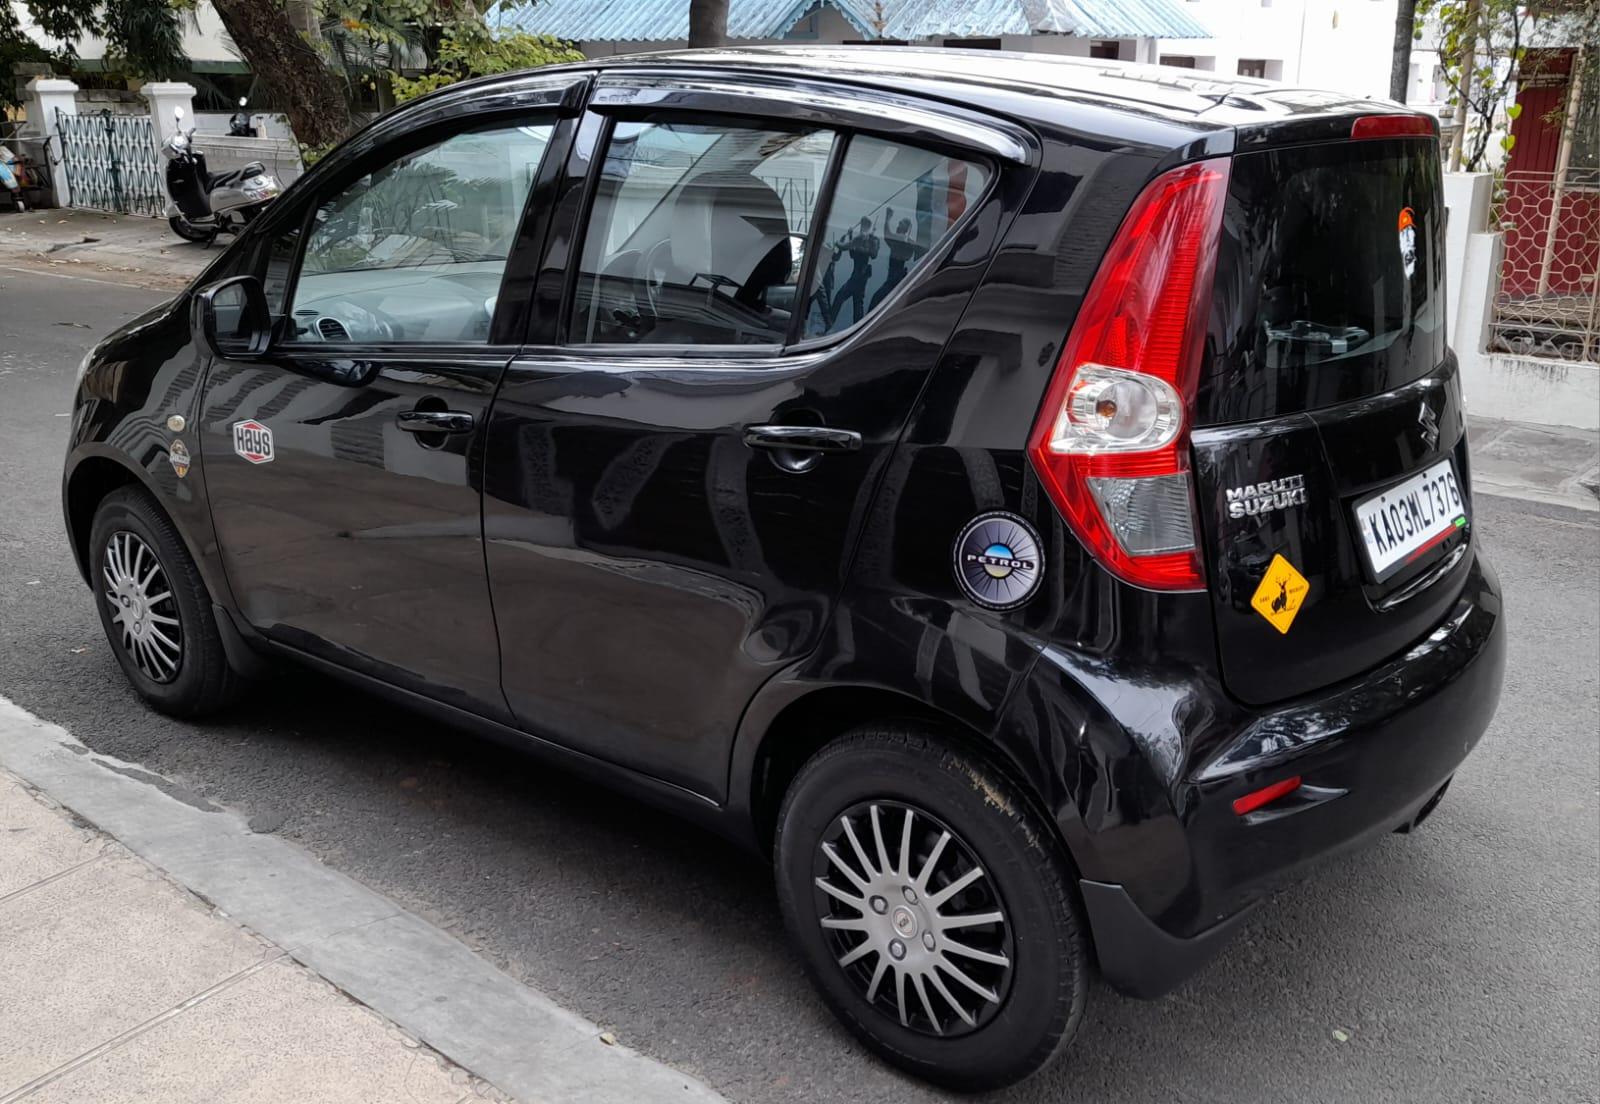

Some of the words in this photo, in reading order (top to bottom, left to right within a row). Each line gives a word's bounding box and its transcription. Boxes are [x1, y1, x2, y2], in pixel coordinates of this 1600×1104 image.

[1226, 474, 1303, 502] MARUTI
[1229, 488, 1306, 518] SUZUKI
[1368, 471, 1460, 556] KA03ML7376
[967, 554, 1032, 569] PETROL
